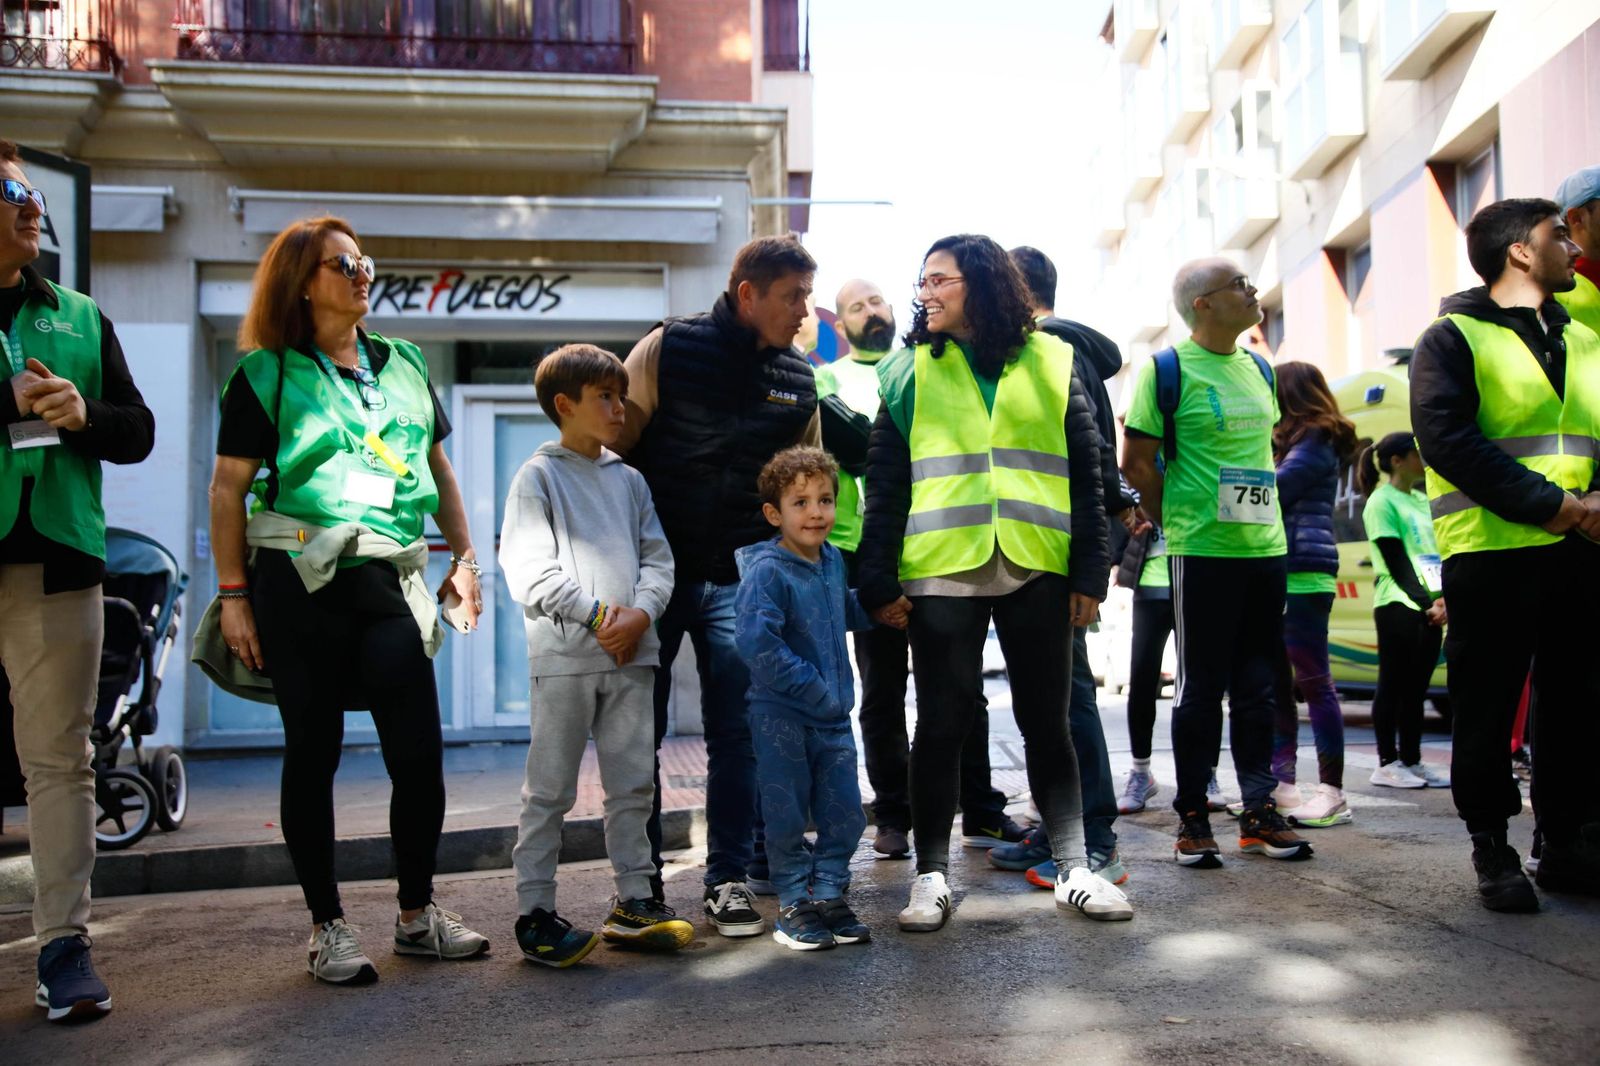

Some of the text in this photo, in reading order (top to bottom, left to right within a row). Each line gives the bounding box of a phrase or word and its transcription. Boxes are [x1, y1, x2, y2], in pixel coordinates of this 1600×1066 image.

[369, 269, 570, 314] TREFUEGOS
[770, 389, 798, 401] CASE
[1234, 486, 1270, 506] 750
